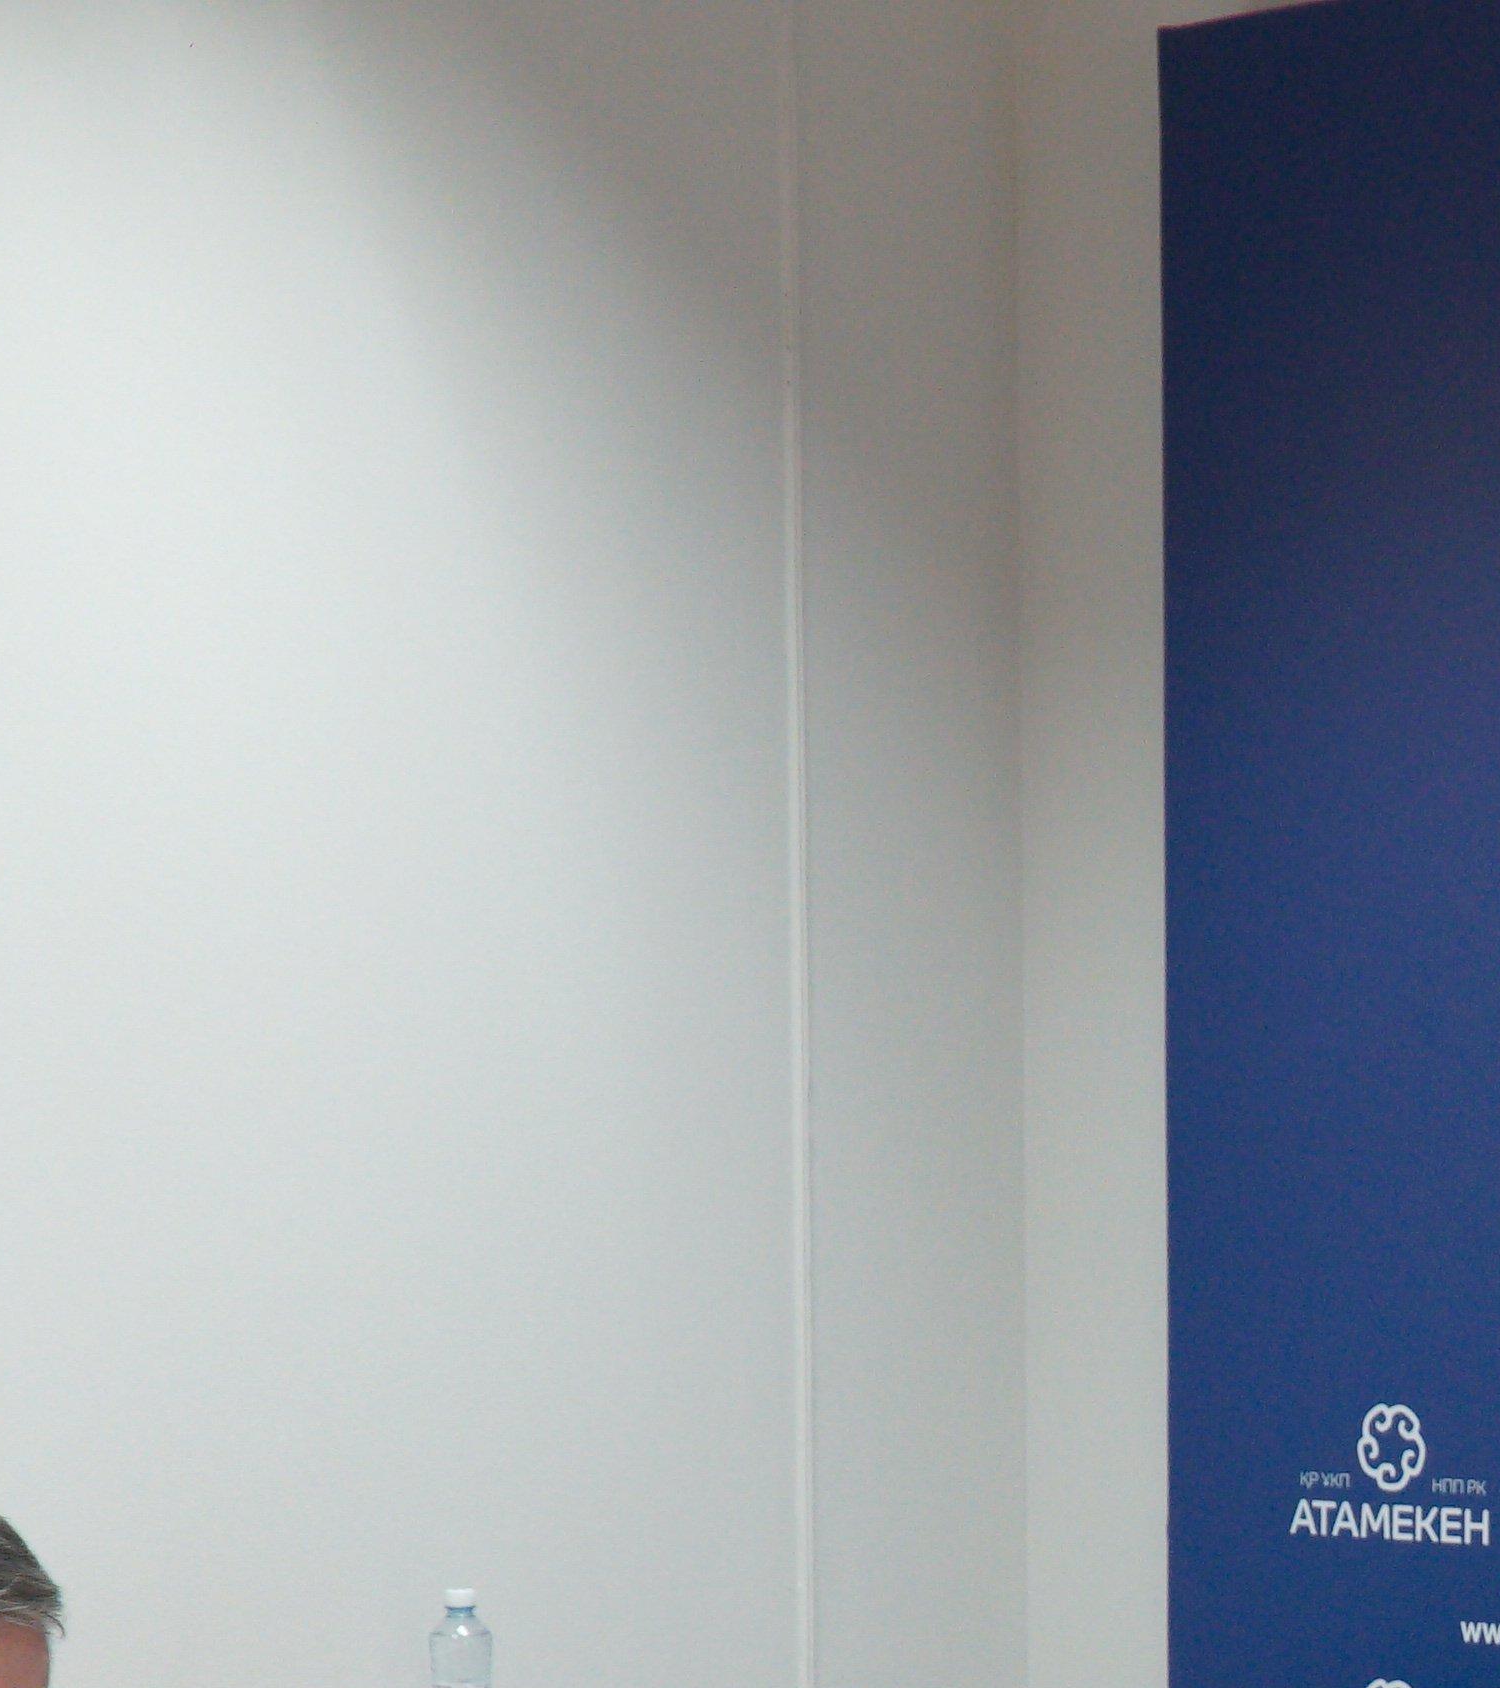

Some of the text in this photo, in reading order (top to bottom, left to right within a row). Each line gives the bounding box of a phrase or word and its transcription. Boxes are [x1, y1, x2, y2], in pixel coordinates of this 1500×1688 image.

[1430, 1477, 1487, 1496] НПП РК
[1289, 1498, 1490, 1546] АТАМЕКЕН
